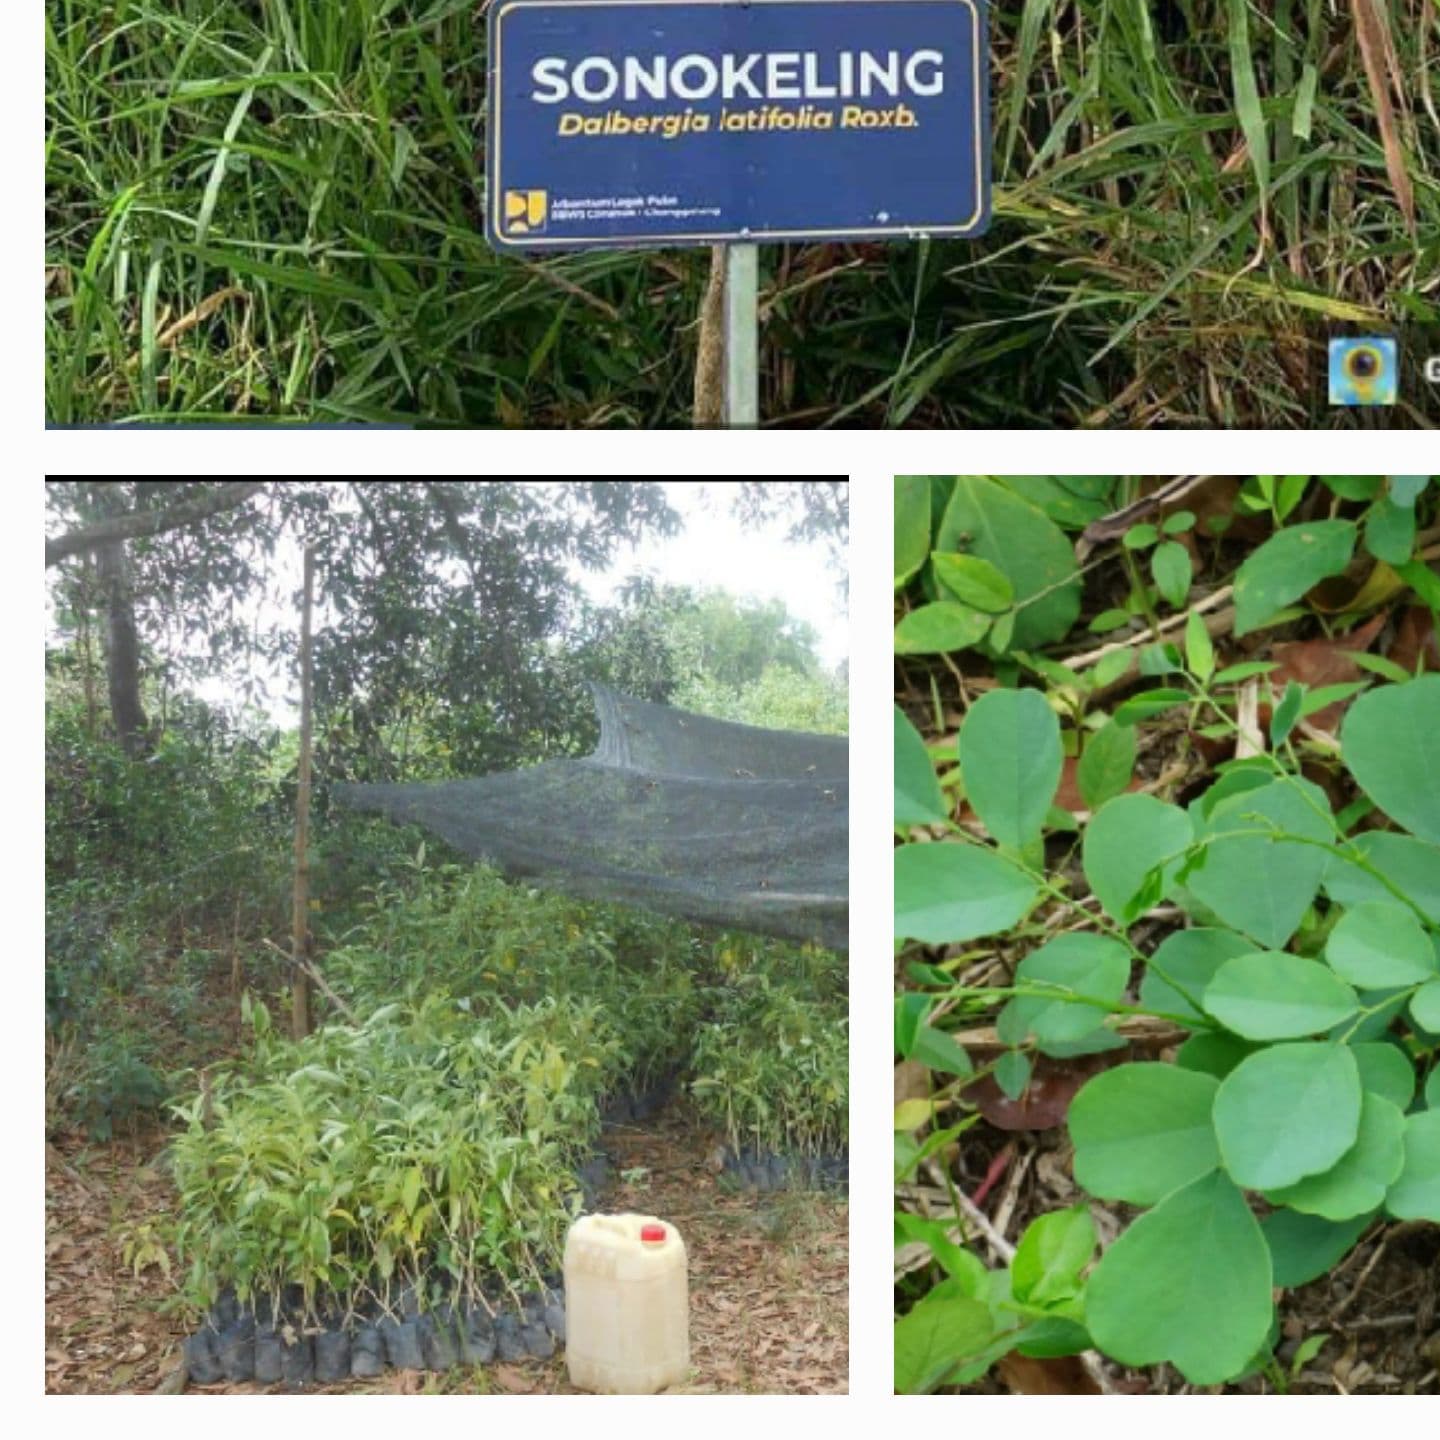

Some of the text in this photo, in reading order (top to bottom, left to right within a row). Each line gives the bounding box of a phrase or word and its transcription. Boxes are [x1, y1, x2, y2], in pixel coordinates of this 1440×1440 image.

[531, 49, 944, 104] SONOKELING
[558, 103, 920, 140] Dalbergia latifolia Roxb.
